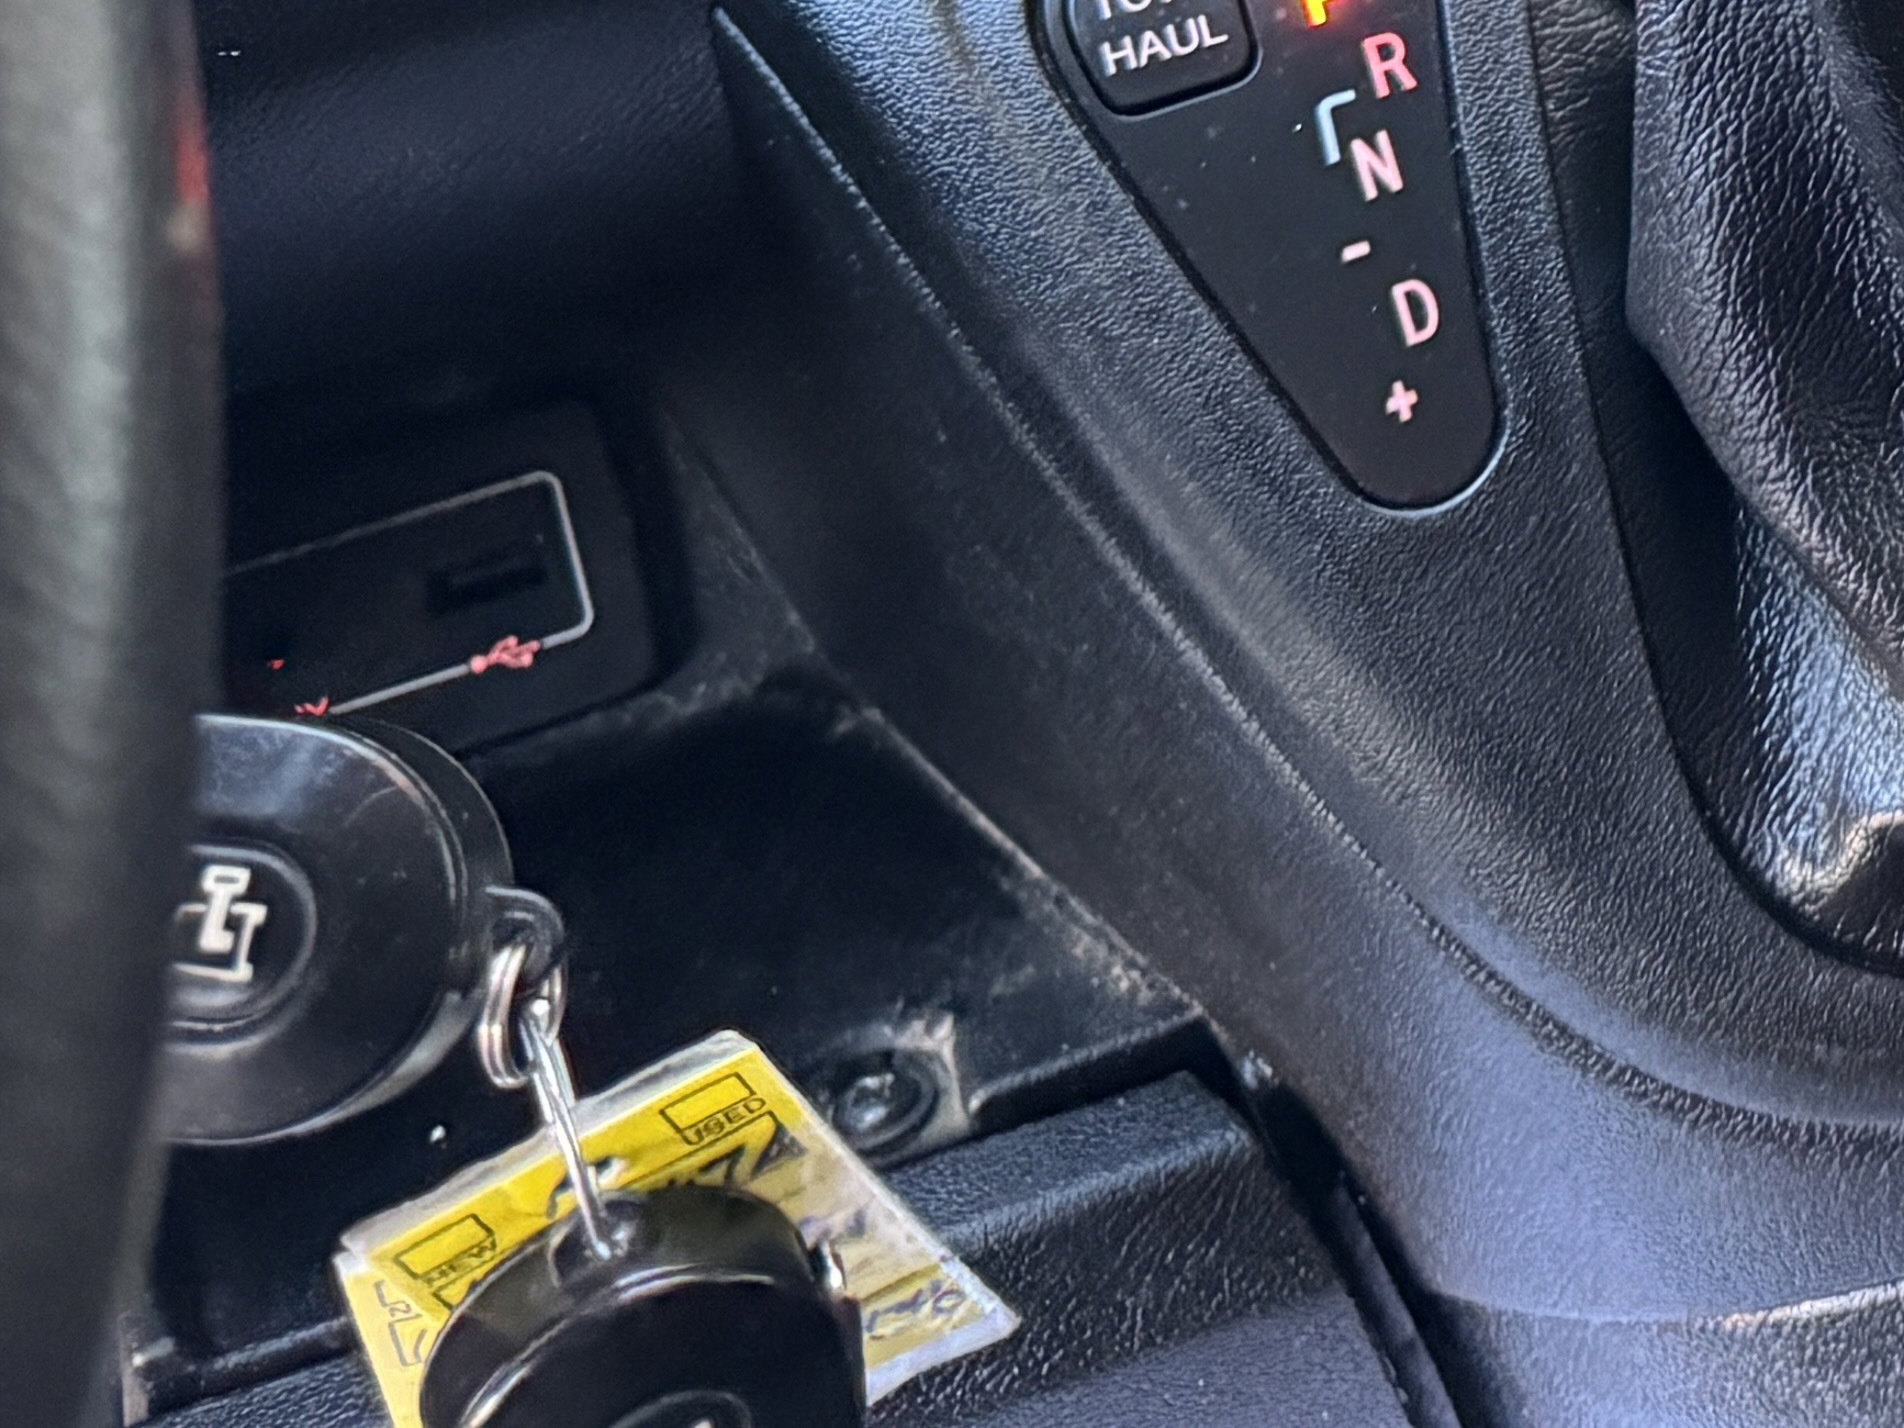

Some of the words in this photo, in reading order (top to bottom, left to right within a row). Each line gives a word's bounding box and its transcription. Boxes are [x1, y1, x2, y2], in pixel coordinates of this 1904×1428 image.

[1099, 14, 1229, 77] HAUL
[1361, 32, 1418, 98] R
[1350, 129, 1404, 201] N
[1391, 279, 1440, 346] D
